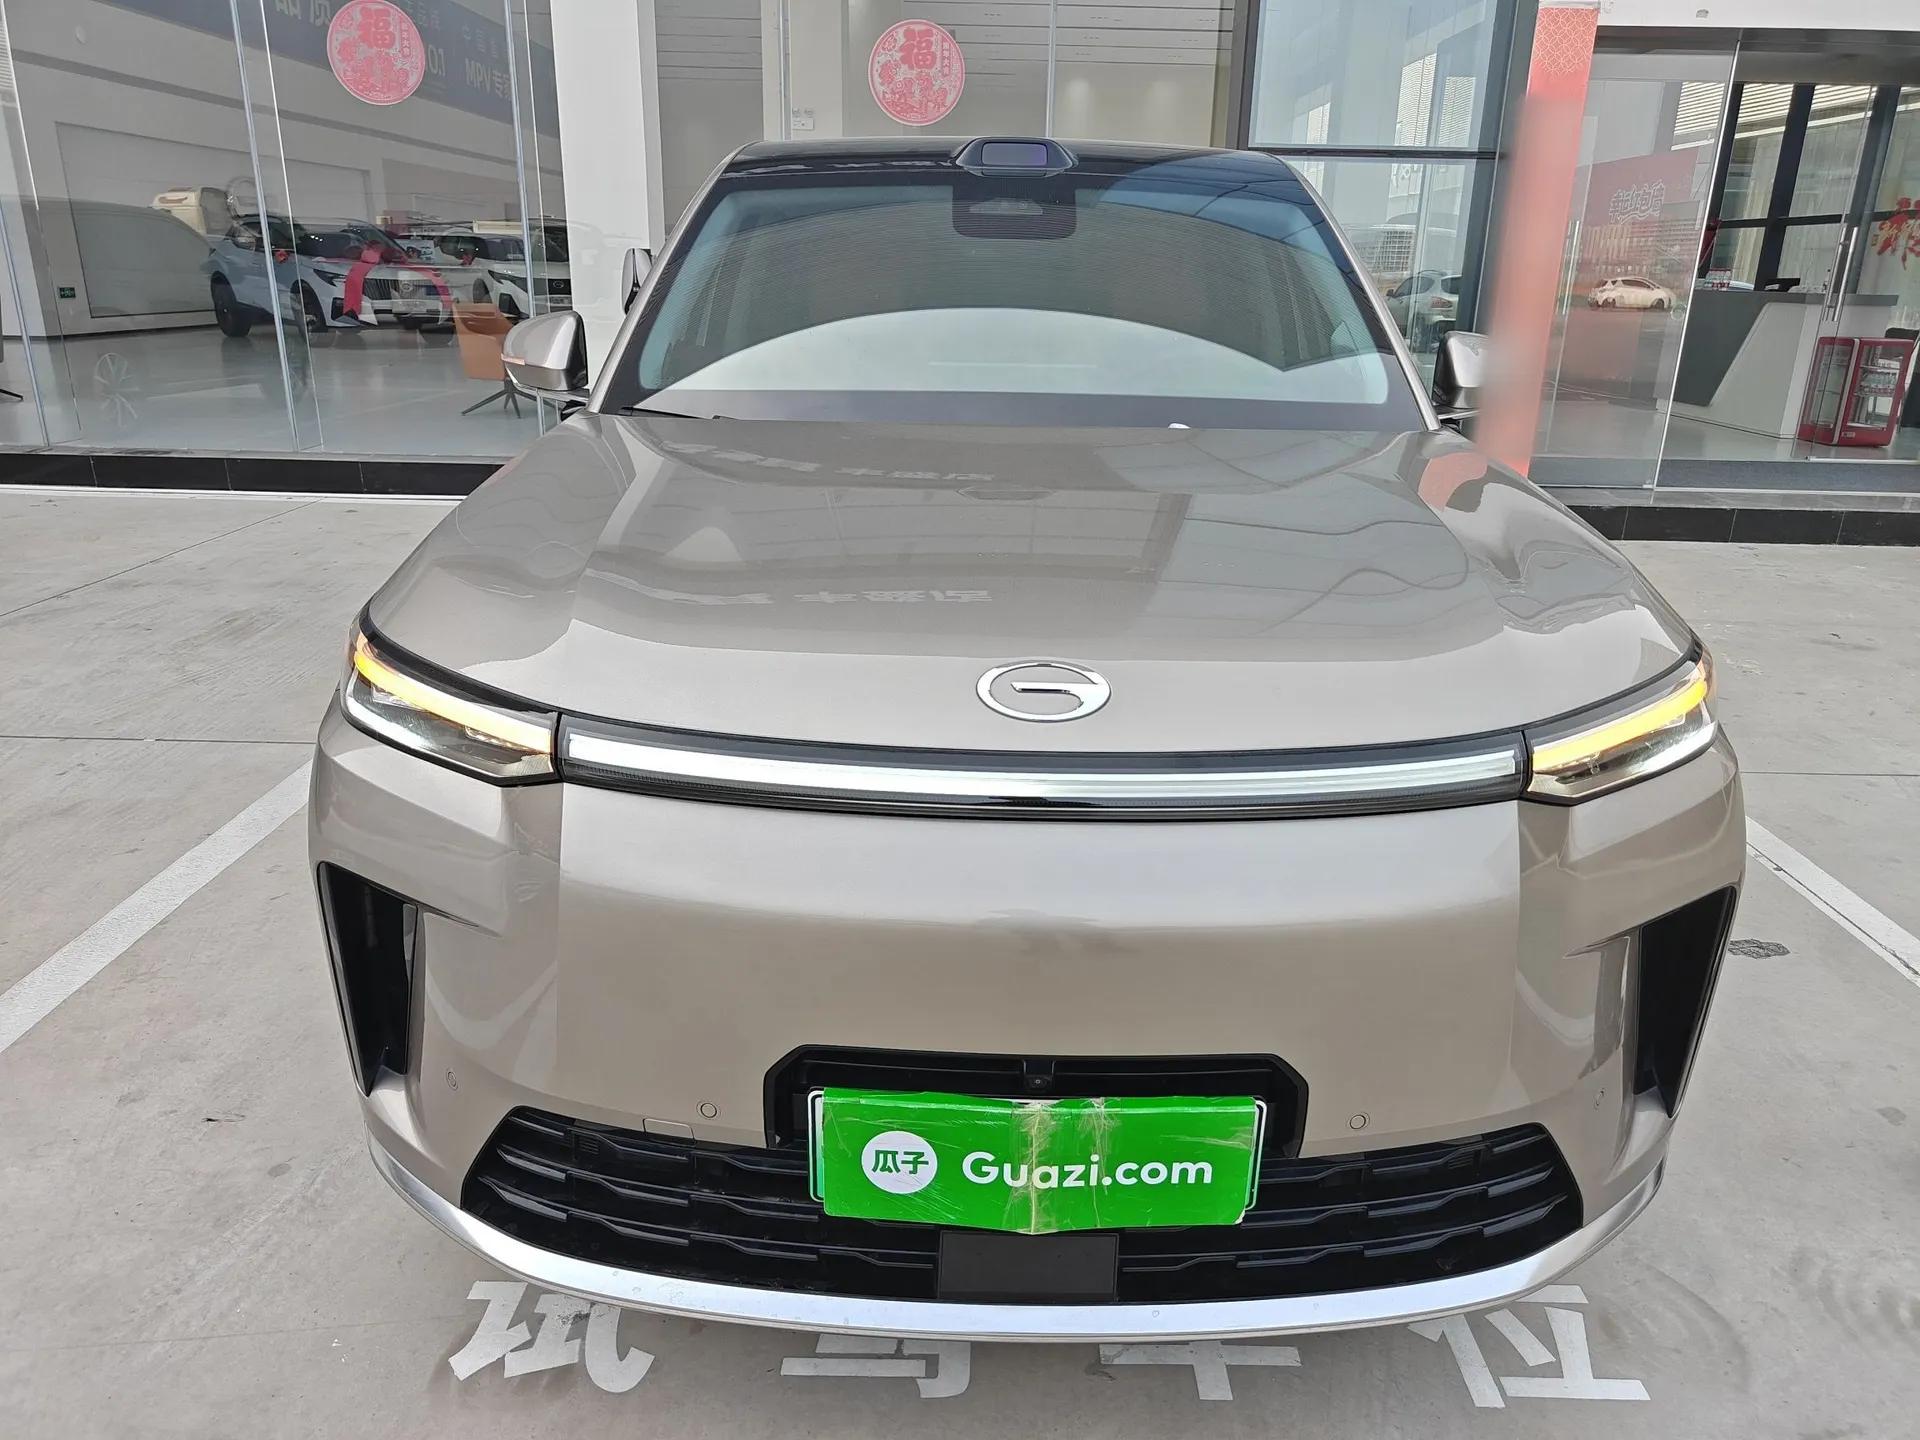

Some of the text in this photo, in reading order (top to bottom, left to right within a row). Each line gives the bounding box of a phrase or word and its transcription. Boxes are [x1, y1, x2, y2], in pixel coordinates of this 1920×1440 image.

[358, 7, 396, 49] 福
[899, 26, 937, 70] 福
[870, 1148, 1213, 1189] 瓜子 Guazi.com
